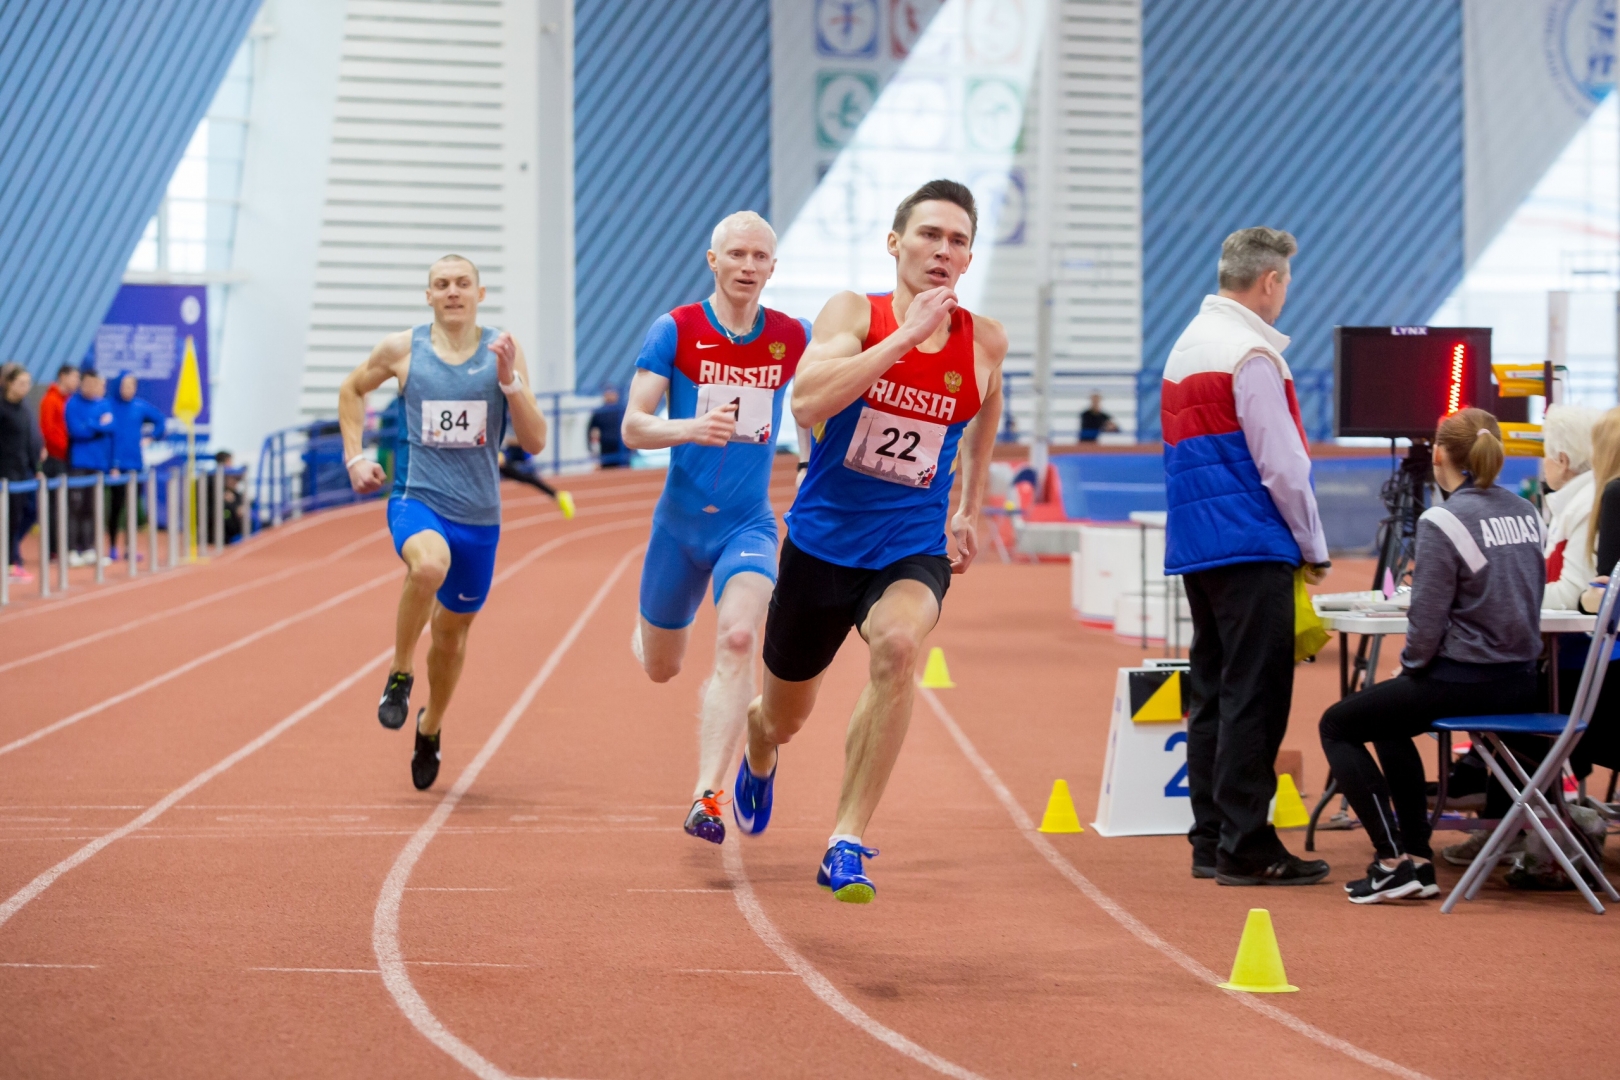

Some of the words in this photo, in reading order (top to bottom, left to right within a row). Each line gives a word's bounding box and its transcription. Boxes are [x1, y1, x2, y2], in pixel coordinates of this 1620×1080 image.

[1391, 326, 1427, 336] LYNX
[699, 359, 782, 388] RUSSIA
[868, 377, 957, 421] RUSSIA
[440, 410, 470, 431] 84
[874, 427, 921, 462] 22
[1480, 514, 1540, 548] ADIDAS
[1164, 731, 1190, 798] 2
